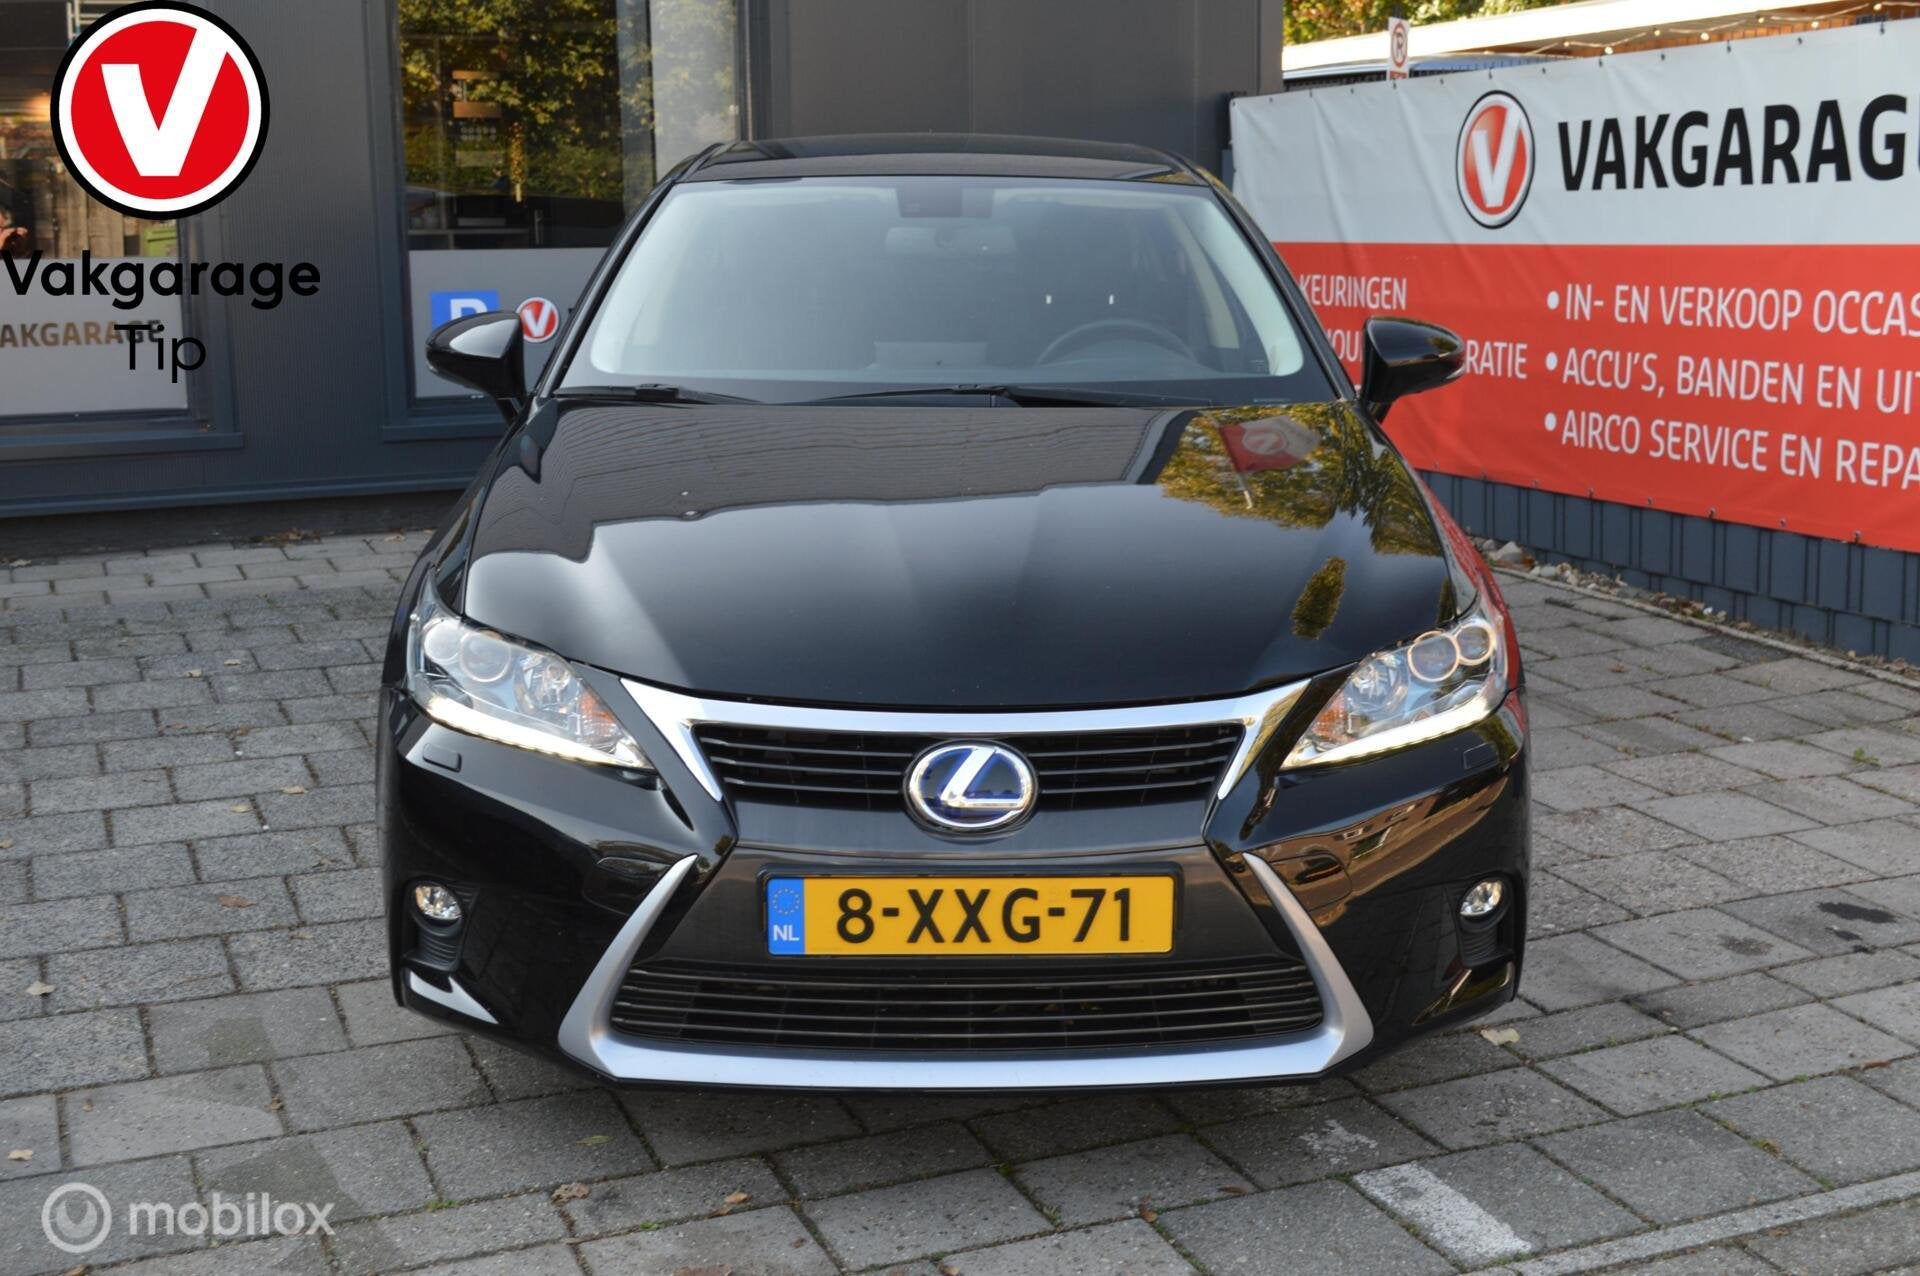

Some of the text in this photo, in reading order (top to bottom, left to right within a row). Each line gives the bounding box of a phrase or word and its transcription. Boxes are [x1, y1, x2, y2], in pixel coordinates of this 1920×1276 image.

[1558, 94, 1920, 191] VAKGARAG
[1300, 274, 1407, 310] KEURINGEN
[1565, 284, 1920, 337] IN- EN VERKOOP OCCAS
[1562, 347, 1920, 415] ACCU'S, BANDEN EN UI
[1561, 409, 1920, 490] AIRCO SERVICE EN REPA
[773, 925, 799, 942] NL
[836, 888, 1131, 944] 8-XXG-71
